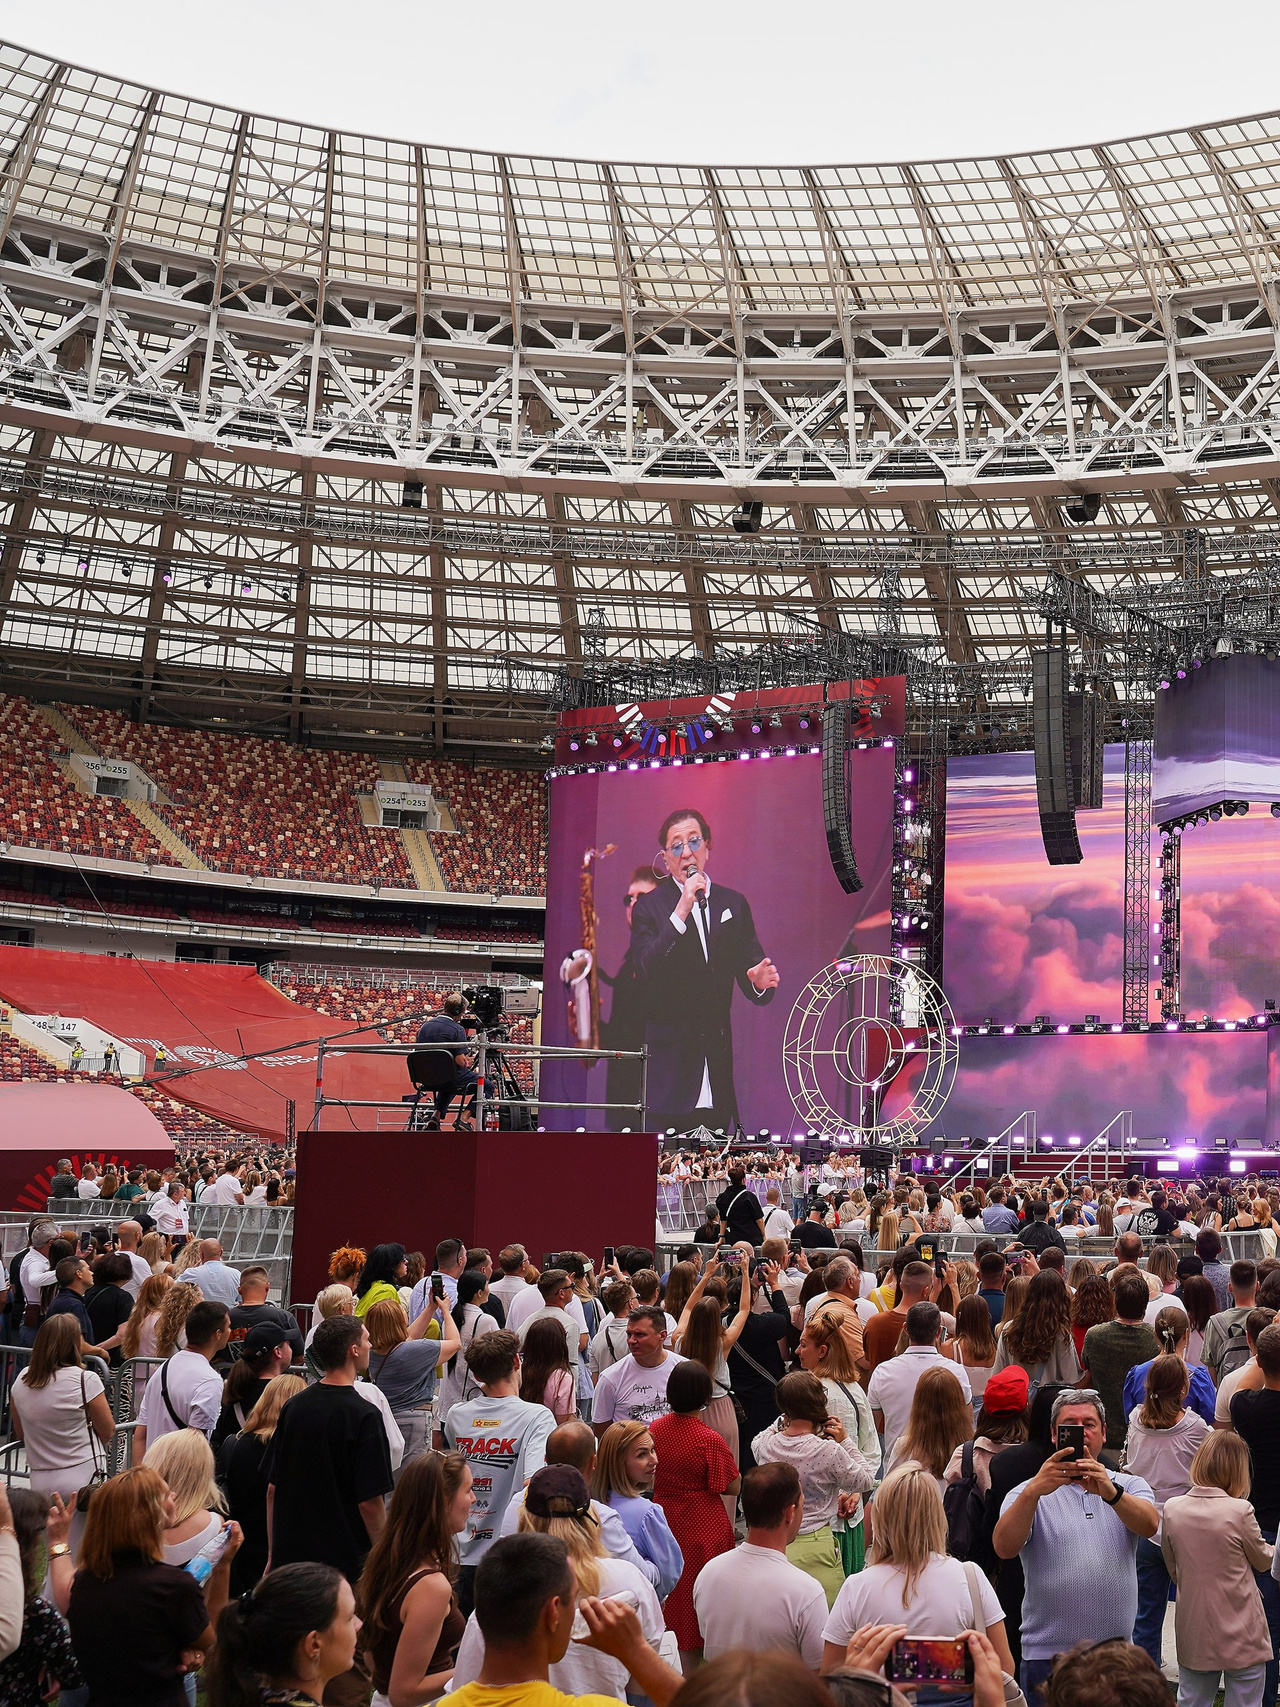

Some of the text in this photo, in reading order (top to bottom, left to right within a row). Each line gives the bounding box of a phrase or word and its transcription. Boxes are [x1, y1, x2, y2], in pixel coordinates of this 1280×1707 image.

[84, 762, 127, 774] 256 255
[386, 797, 427, 807] 254 253
[60, 1022, 77, 1031] 147
[455, 1437, 517, 1454] TRACK
